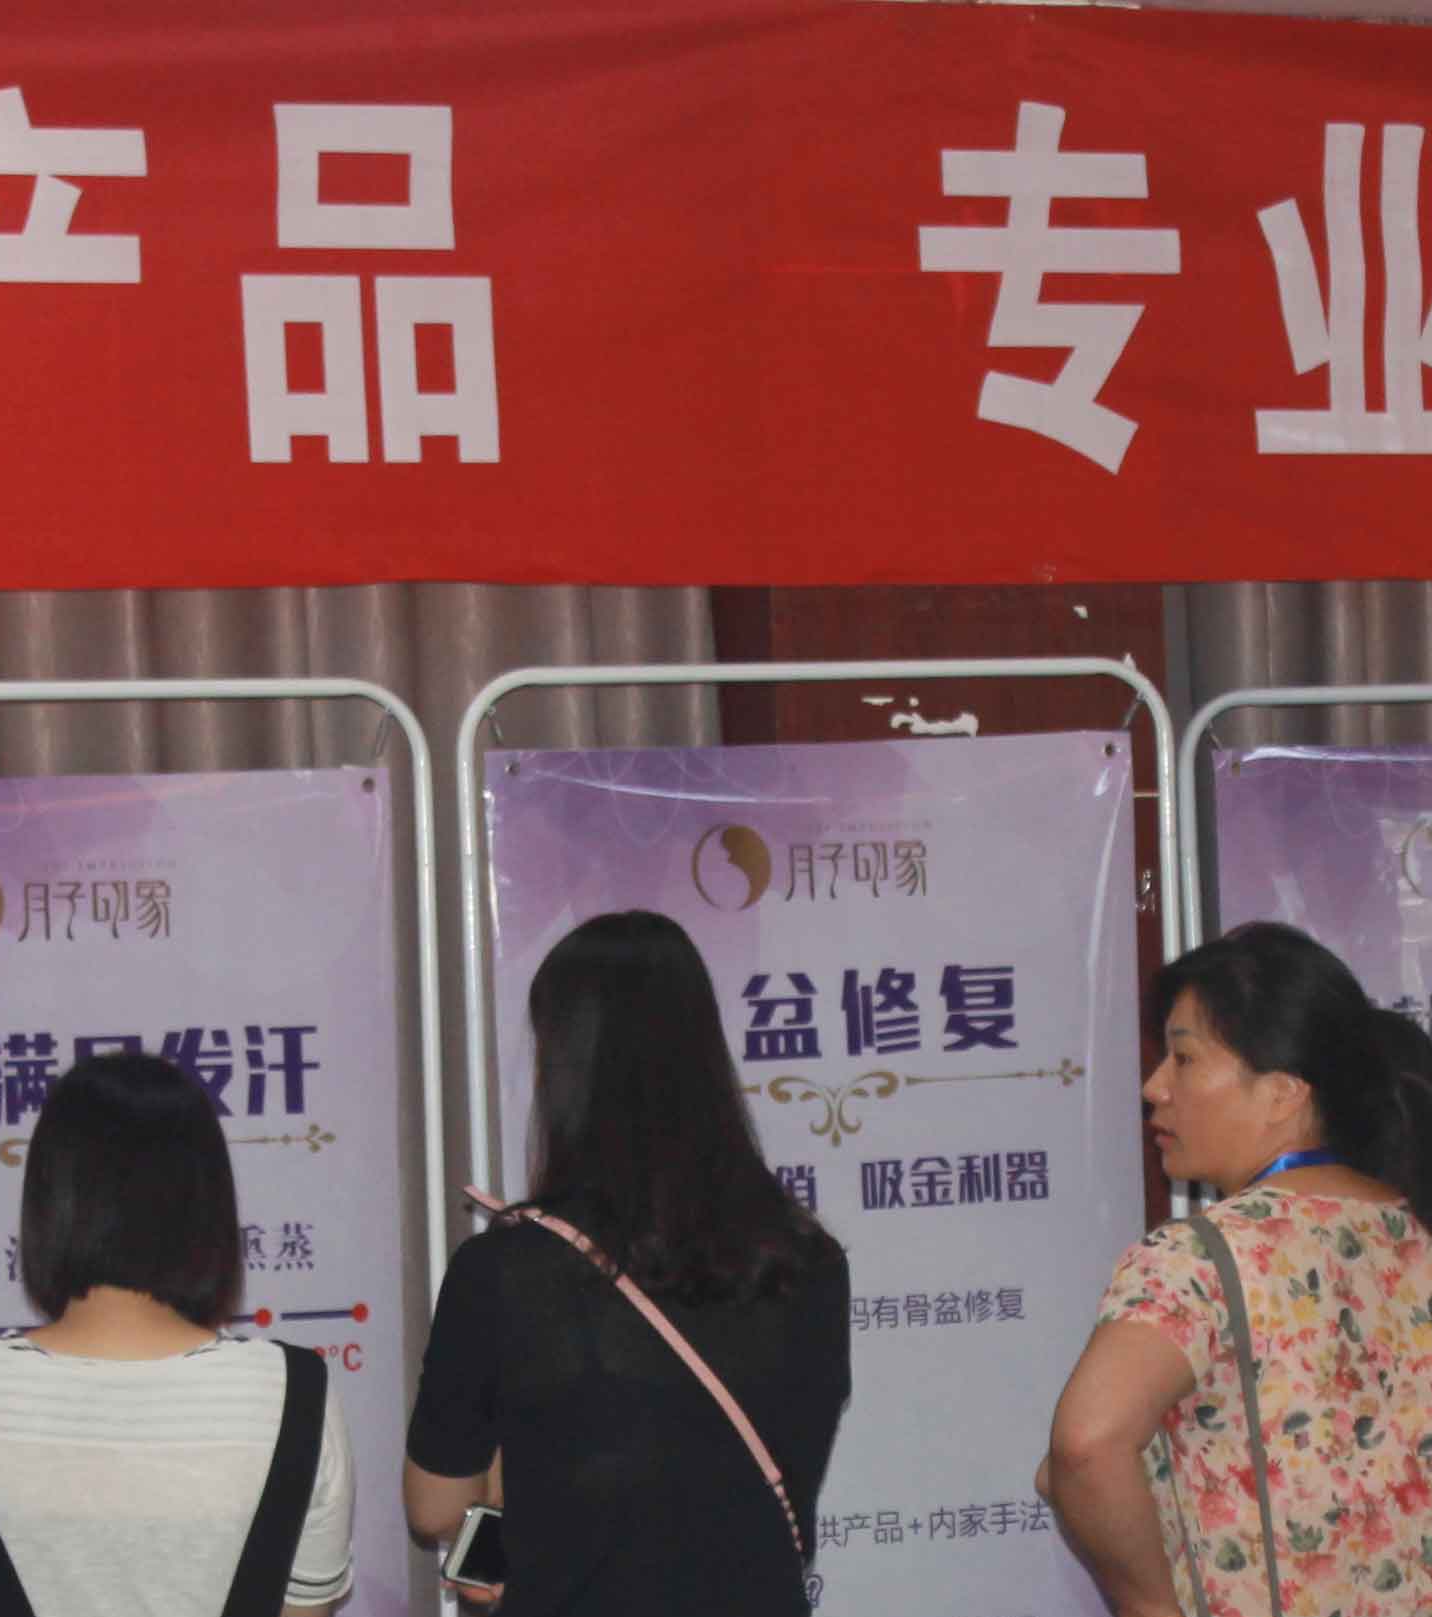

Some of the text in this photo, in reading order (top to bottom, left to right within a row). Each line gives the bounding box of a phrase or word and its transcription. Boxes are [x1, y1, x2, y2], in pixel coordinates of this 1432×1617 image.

[785, 840, 929, 901] 月子印象
[18, 879, 173, 943] 月子印象
[741, 964, 1020, 1062] 盆修复
[861, 1151, 1049, 1211] 吸金利器
